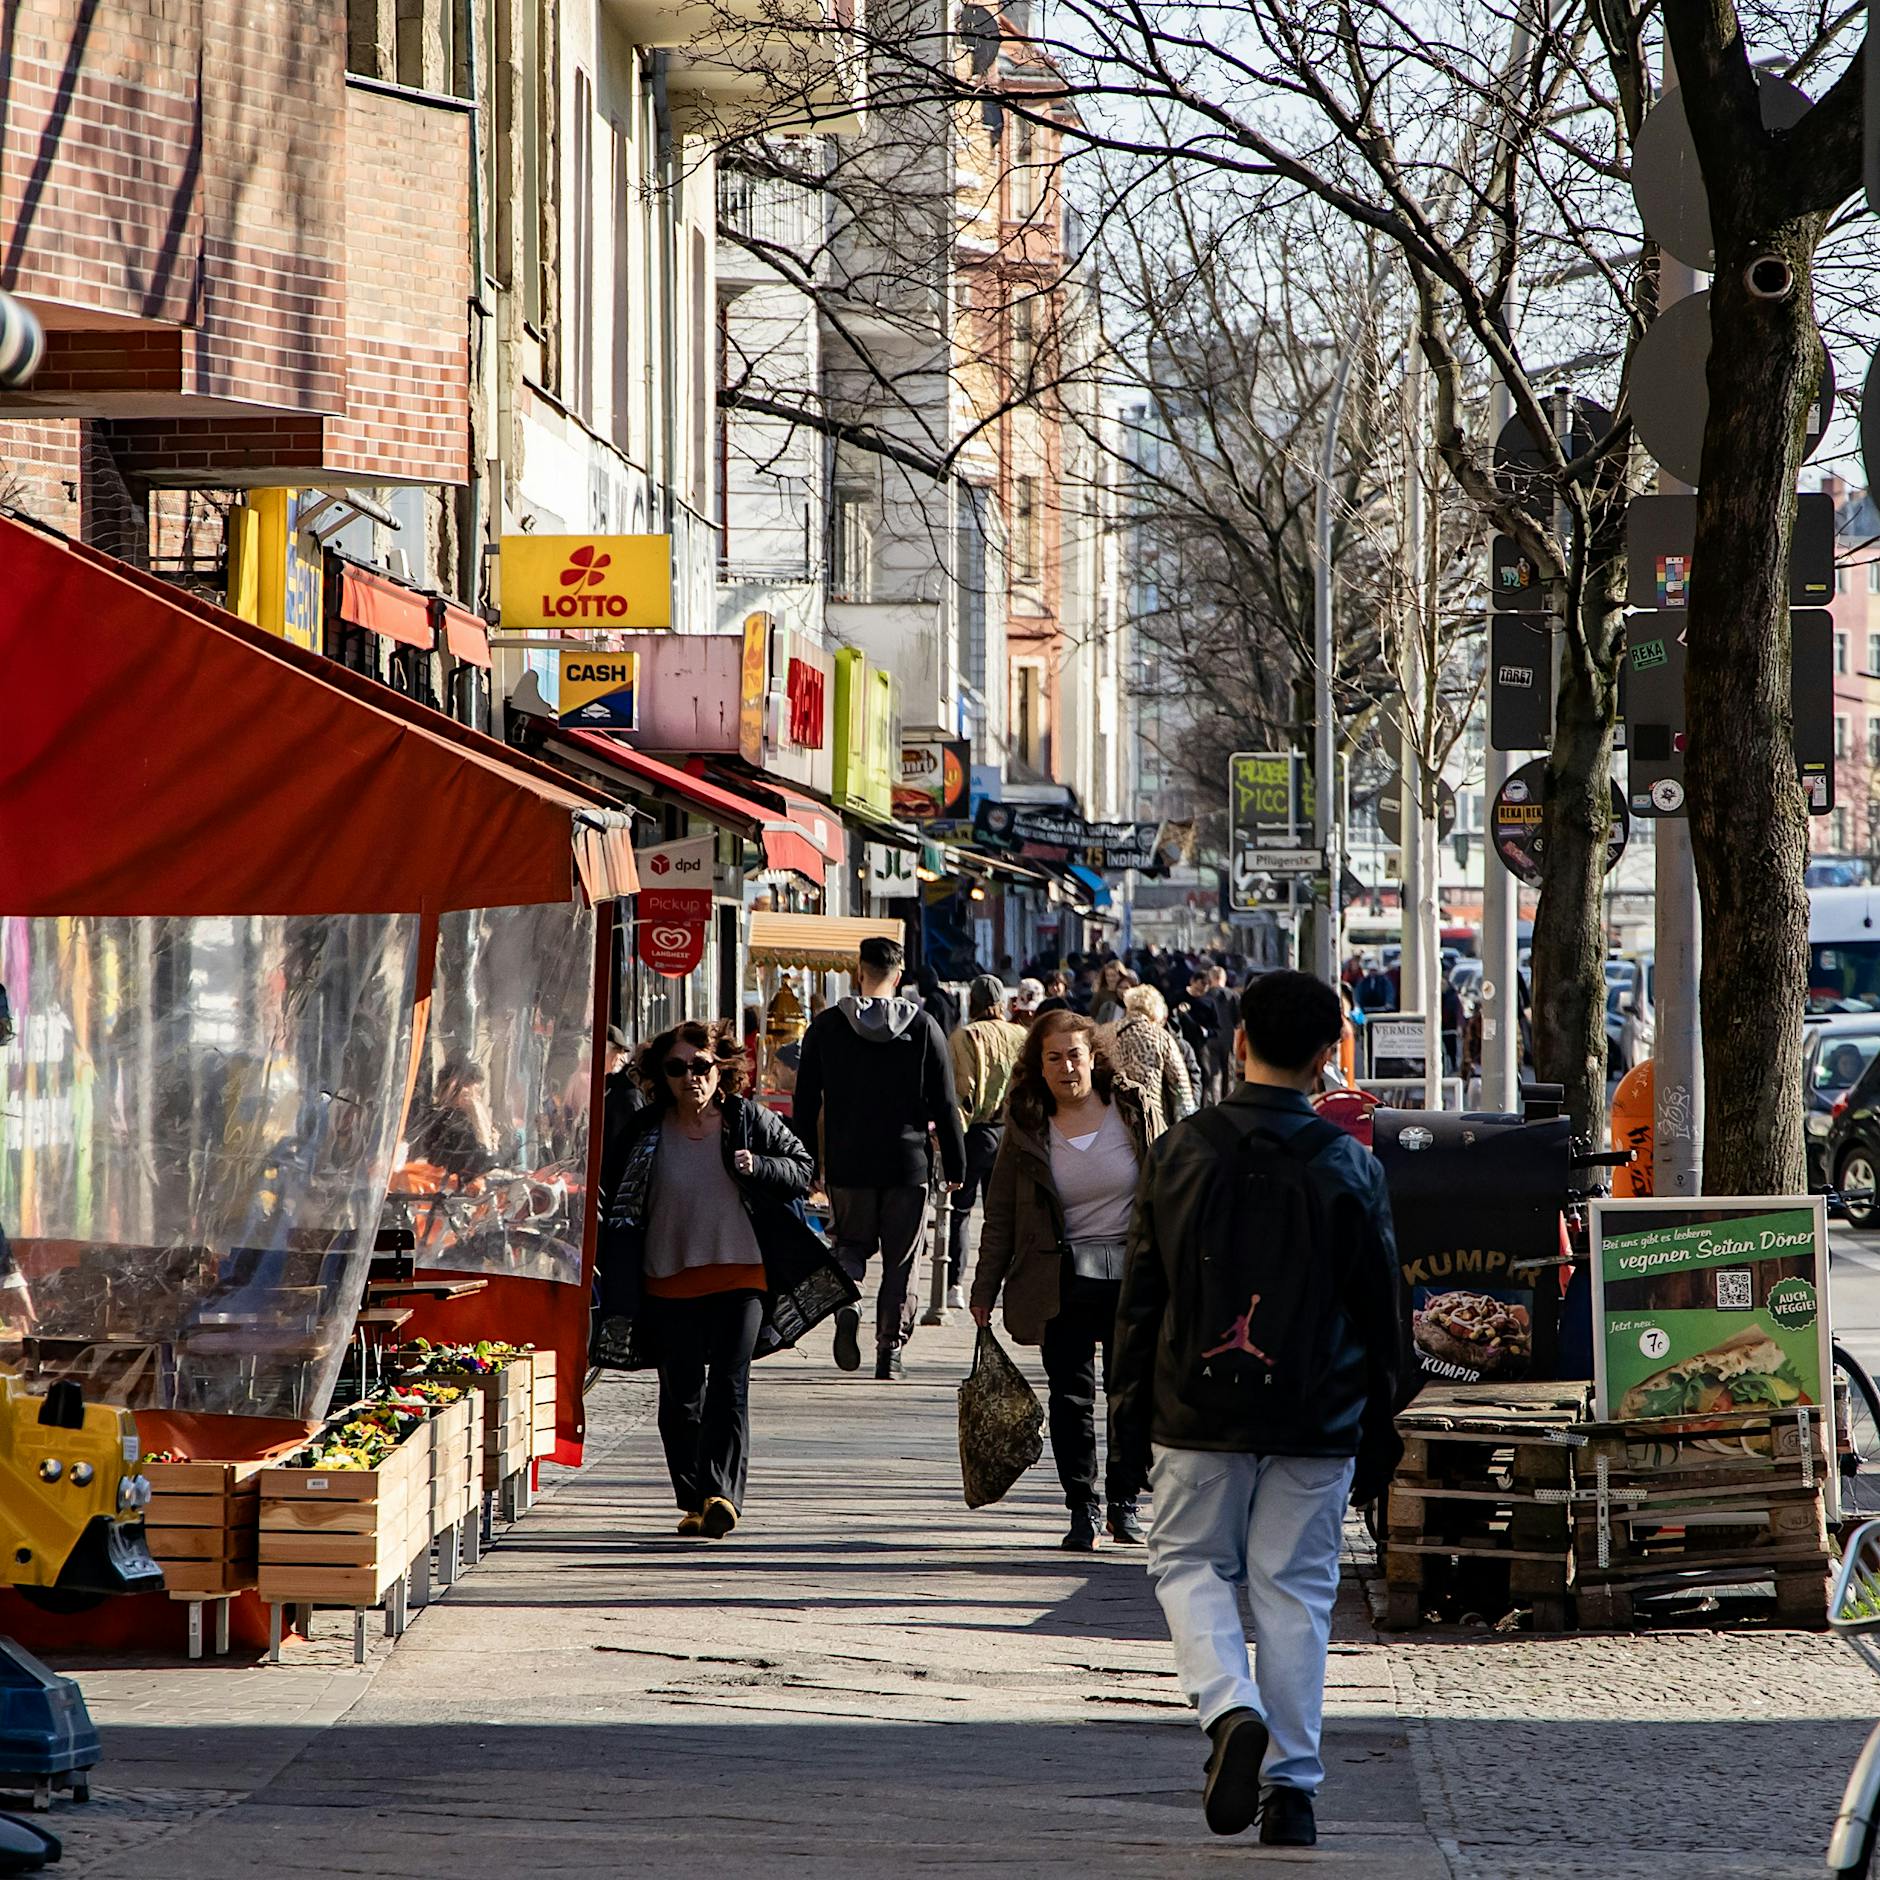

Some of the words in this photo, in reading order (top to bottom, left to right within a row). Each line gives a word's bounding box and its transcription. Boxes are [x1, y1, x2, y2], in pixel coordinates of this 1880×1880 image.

[543, 595, 628, 617] LOTTO
[1631, 643, 1663, 662] REKA
[566, 664, 626, 681] CASH
[1526, 805, 1543, 818] REK
[675, 858, 701, 873] dpd
[649, 897, 700, 913] Pickup
[1374, 1025, 1425, 1036] VERMISS
[1602, 1239, 1619, 1251] Bei
[1621, 1239, 1638, 1249] uns
[1641, 1234, 1659, 1249] gibt
[1661, 1235, 1672, 1243] es
[1674, 1228, 1713, 1242] leckeren
[1619, 1250, 1691, 1273] veganen
[1696, 1239, 1756, 1259] Seitan
[1760, 1231, 1815, 1250] Döner
[1779, 1291, 1808, 1305] AUCH
[1774, 1300, 1817, 1315] VEGGIE!
[1609, 1321, 1634, 1334] Jetzt
[1202, 1366, 1272, 1384] AIR
[1421, 1357, 1480, 1383] KUMPIR
